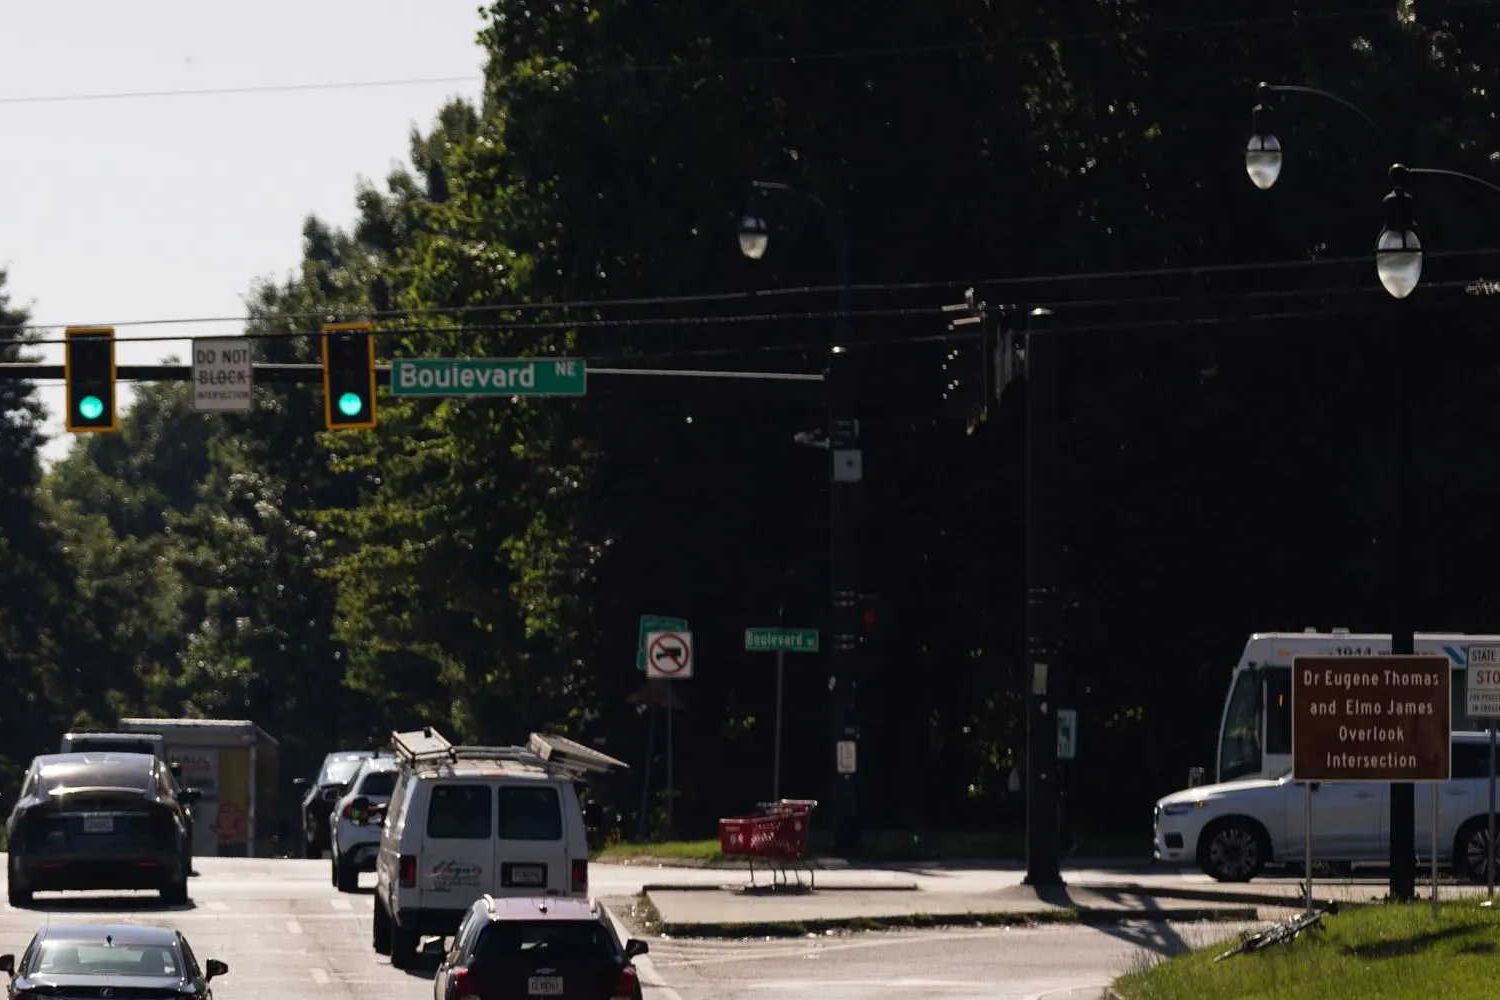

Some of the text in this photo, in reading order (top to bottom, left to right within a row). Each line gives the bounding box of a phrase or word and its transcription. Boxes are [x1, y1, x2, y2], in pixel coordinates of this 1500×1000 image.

[196, 348, 249, 365] DO NOT
[199, 368, 246, 386] BLOCK
[400, 361, 576, 388] Boulevard NE
[746, 630, 803, 648] Boulevard
[1472, 649, 1496, 662] STATE
[1304, 670, 1439, 690] Dr Eugene Thomas
[1476, 669, 1500, 685] STO
[1310, 699, 1433, 716] and Elmo James
[1339, 725, 1404, 742] Overlook
[1327, 751, 1417, 768] Intersection
